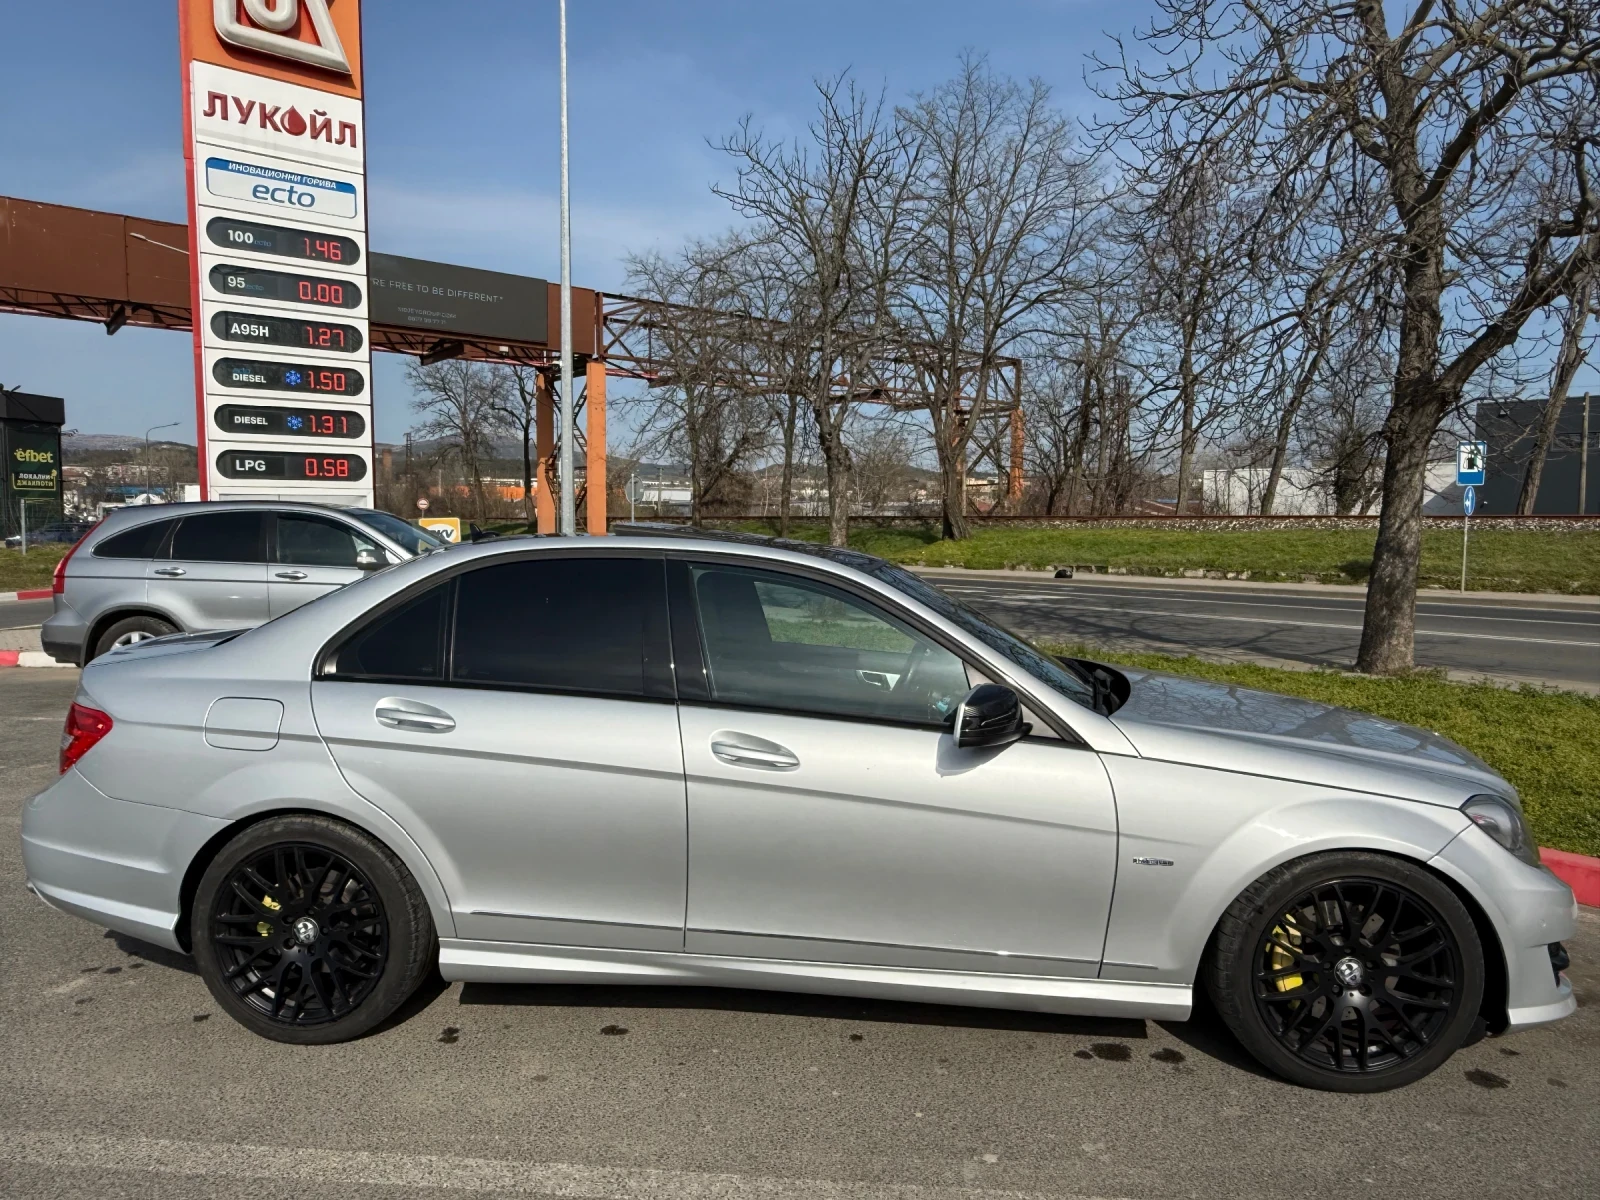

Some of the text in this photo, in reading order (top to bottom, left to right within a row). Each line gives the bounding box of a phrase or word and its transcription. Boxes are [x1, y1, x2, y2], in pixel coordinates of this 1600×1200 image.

[203, 90, 357, 148] ЛУКОЙЛ
[228, 162, 337, 189] ИНОВАЦИОННИ ГОРИВА
[252, 183, 316, 208] ecto
[227, 229, 254, 244] 100
[304, 237, 342, 261] 1.46
[227, 275, 246, 289] 95
[298, 281, 343, 304] 0.00
[389, 280, 414, 292] FREE
[416, 284, 429, 293] TO
[432, 287, 444, 296] BE
[230, 322, 345, 347] A95H 1.27
[232, 371, 346, 391] DIESEL 1.50
[234, 415, 347, 434] DIESEL 1.31
[15, 449, 54, 463] efbet
[235, 458, 349, 477] LPG 0.58
